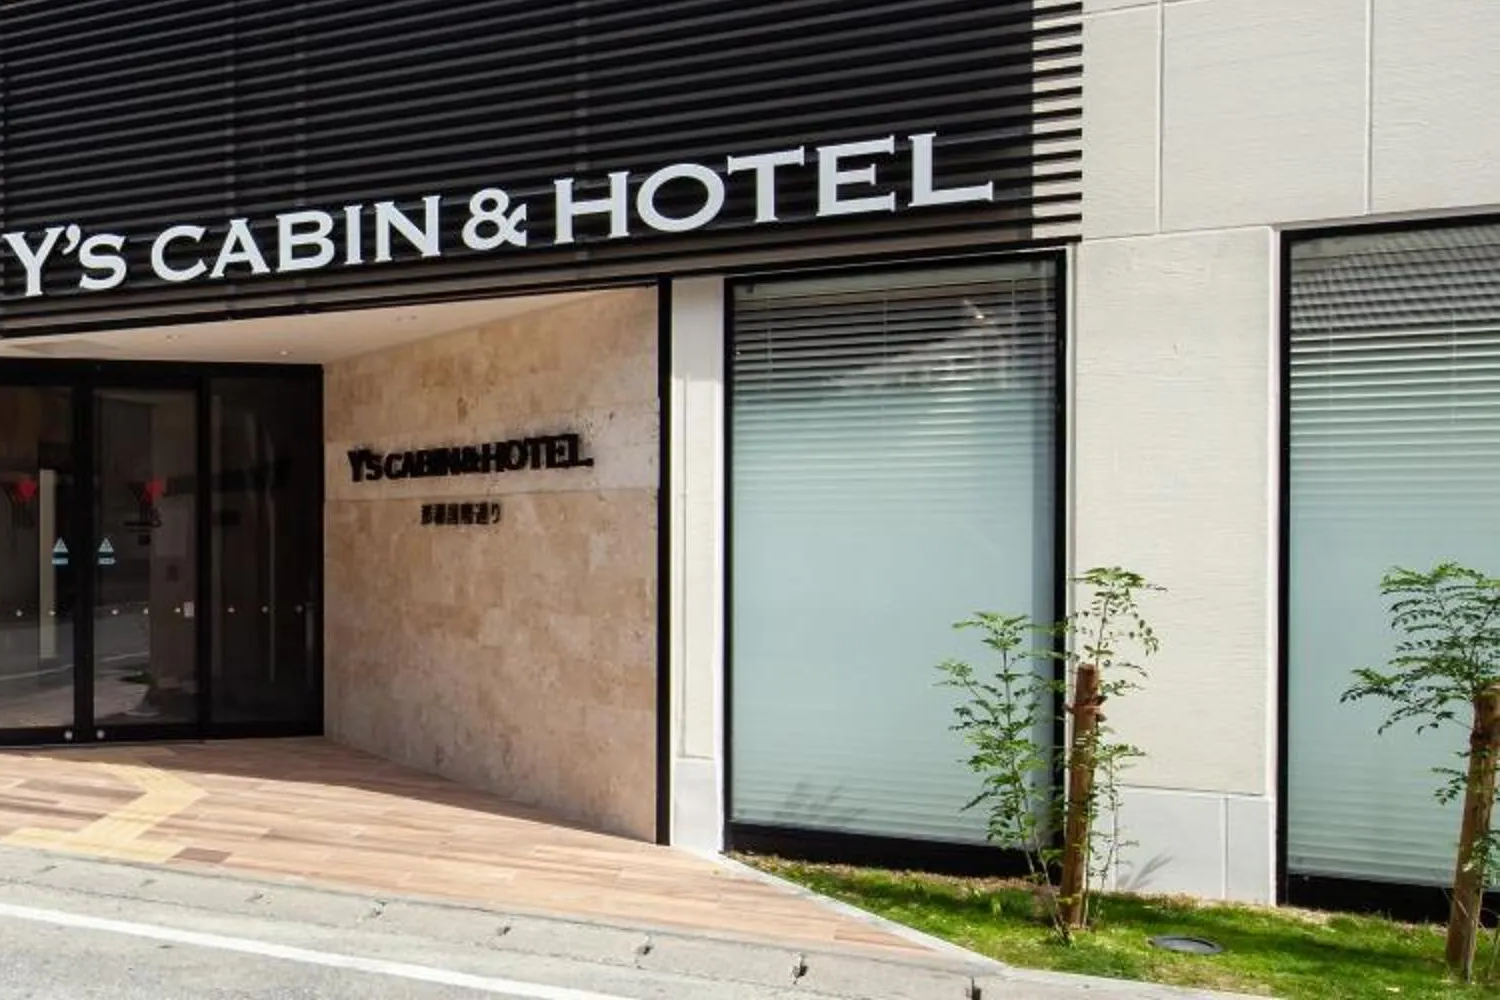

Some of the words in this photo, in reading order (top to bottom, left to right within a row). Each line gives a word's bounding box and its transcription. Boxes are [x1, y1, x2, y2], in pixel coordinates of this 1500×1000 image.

[2, 223, 128, 298] Y'S
[151, 195, 441, 282] CABIN
[461, 187, 528, 251] &
[553, 132, 994, 245] HOTEL
